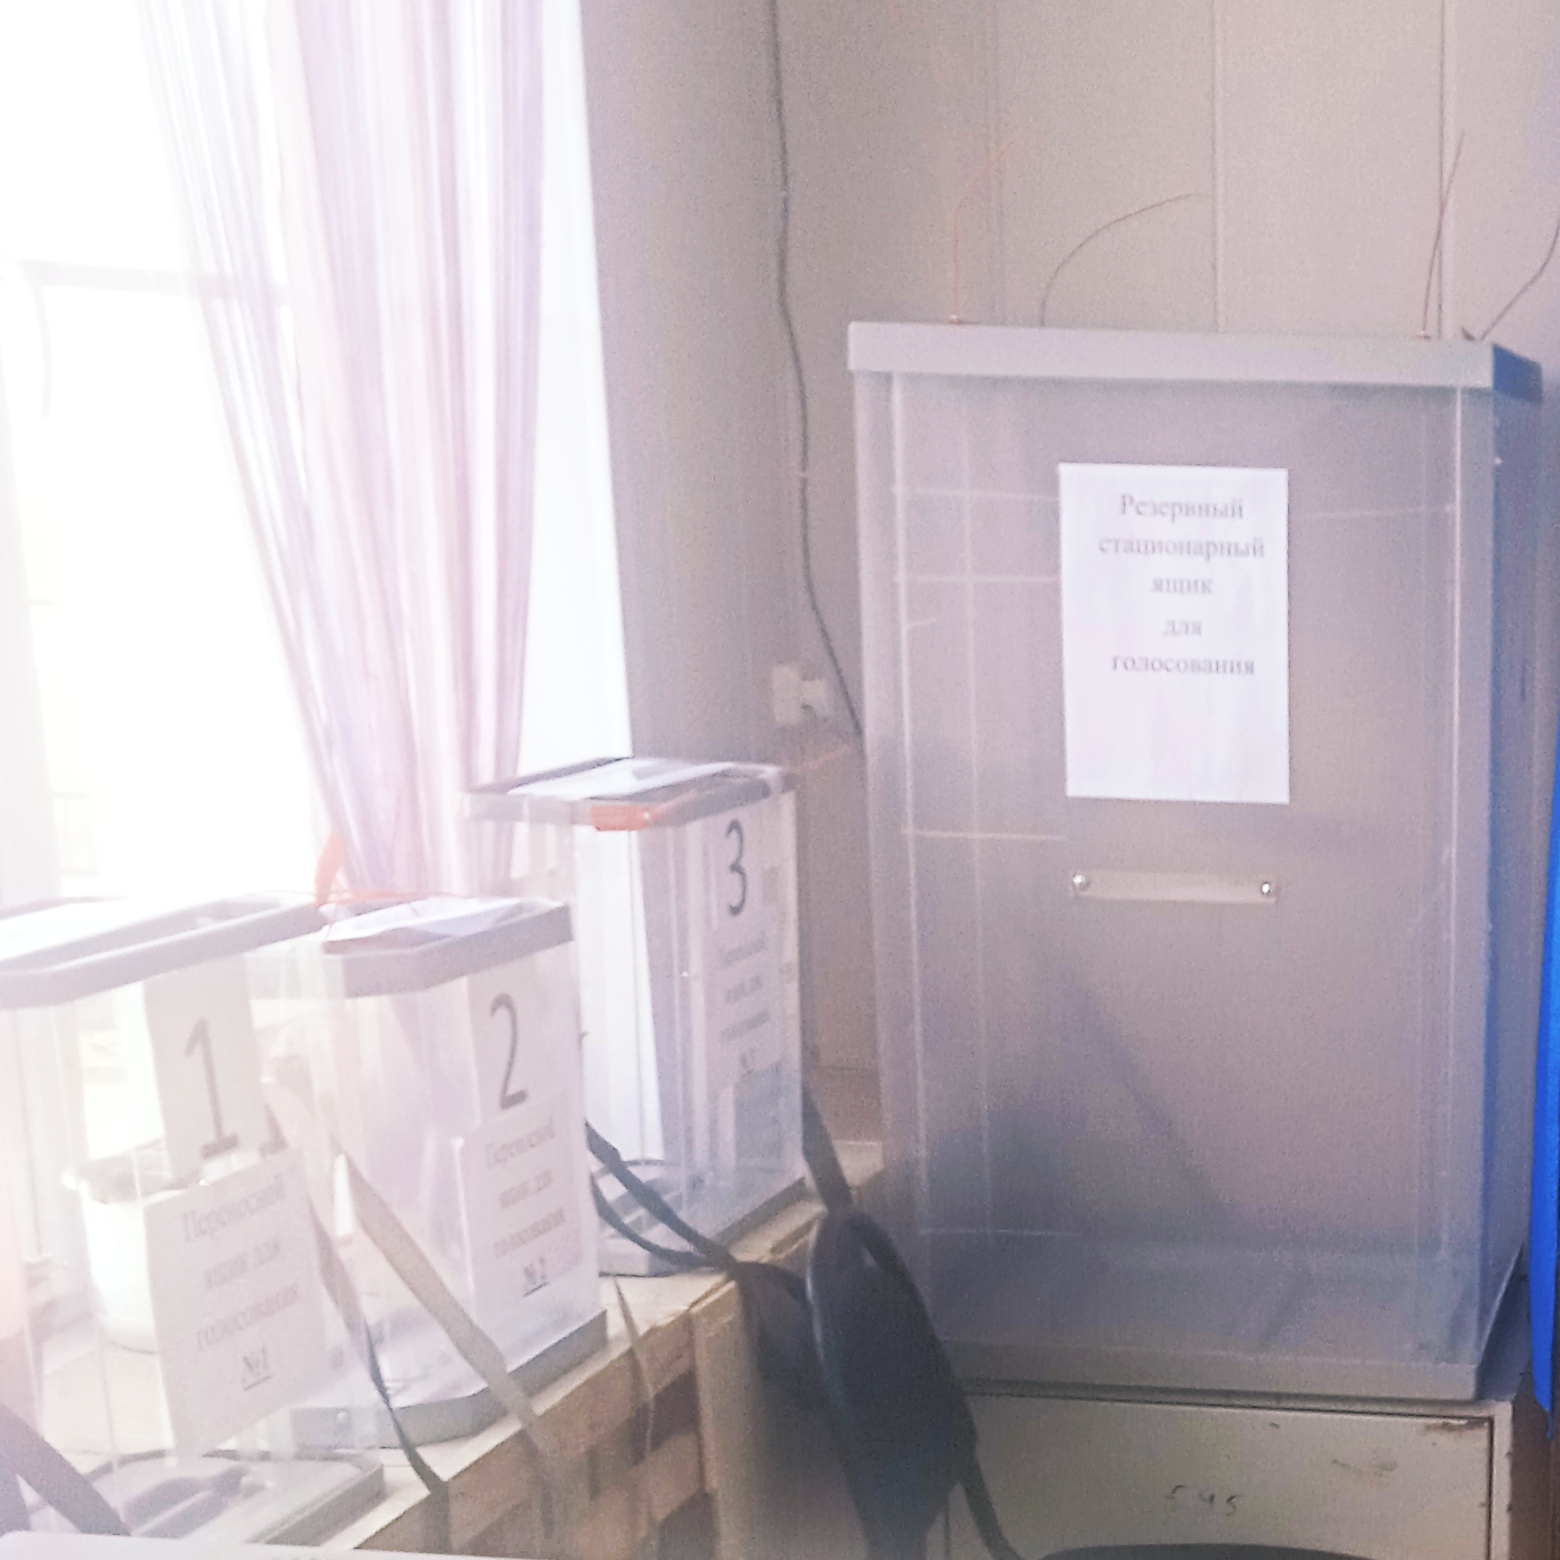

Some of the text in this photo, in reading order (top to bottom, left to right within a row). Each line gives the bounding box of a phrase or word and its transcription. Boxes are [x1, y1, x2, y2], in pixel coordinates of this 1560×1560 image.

[1120, 494, 1244, 522] Резервный
[1099, 535, 1265, 561] стационарный
[1152, 575, 1213, 597] ящик
[1162, 618, 1203, 637] для
[1112, 654, 1255, 675] голосования
[725, 819, 747, 916] 3
[488, 993, 528, 1111] 2
[184, 1017, 239, 1158] 1
